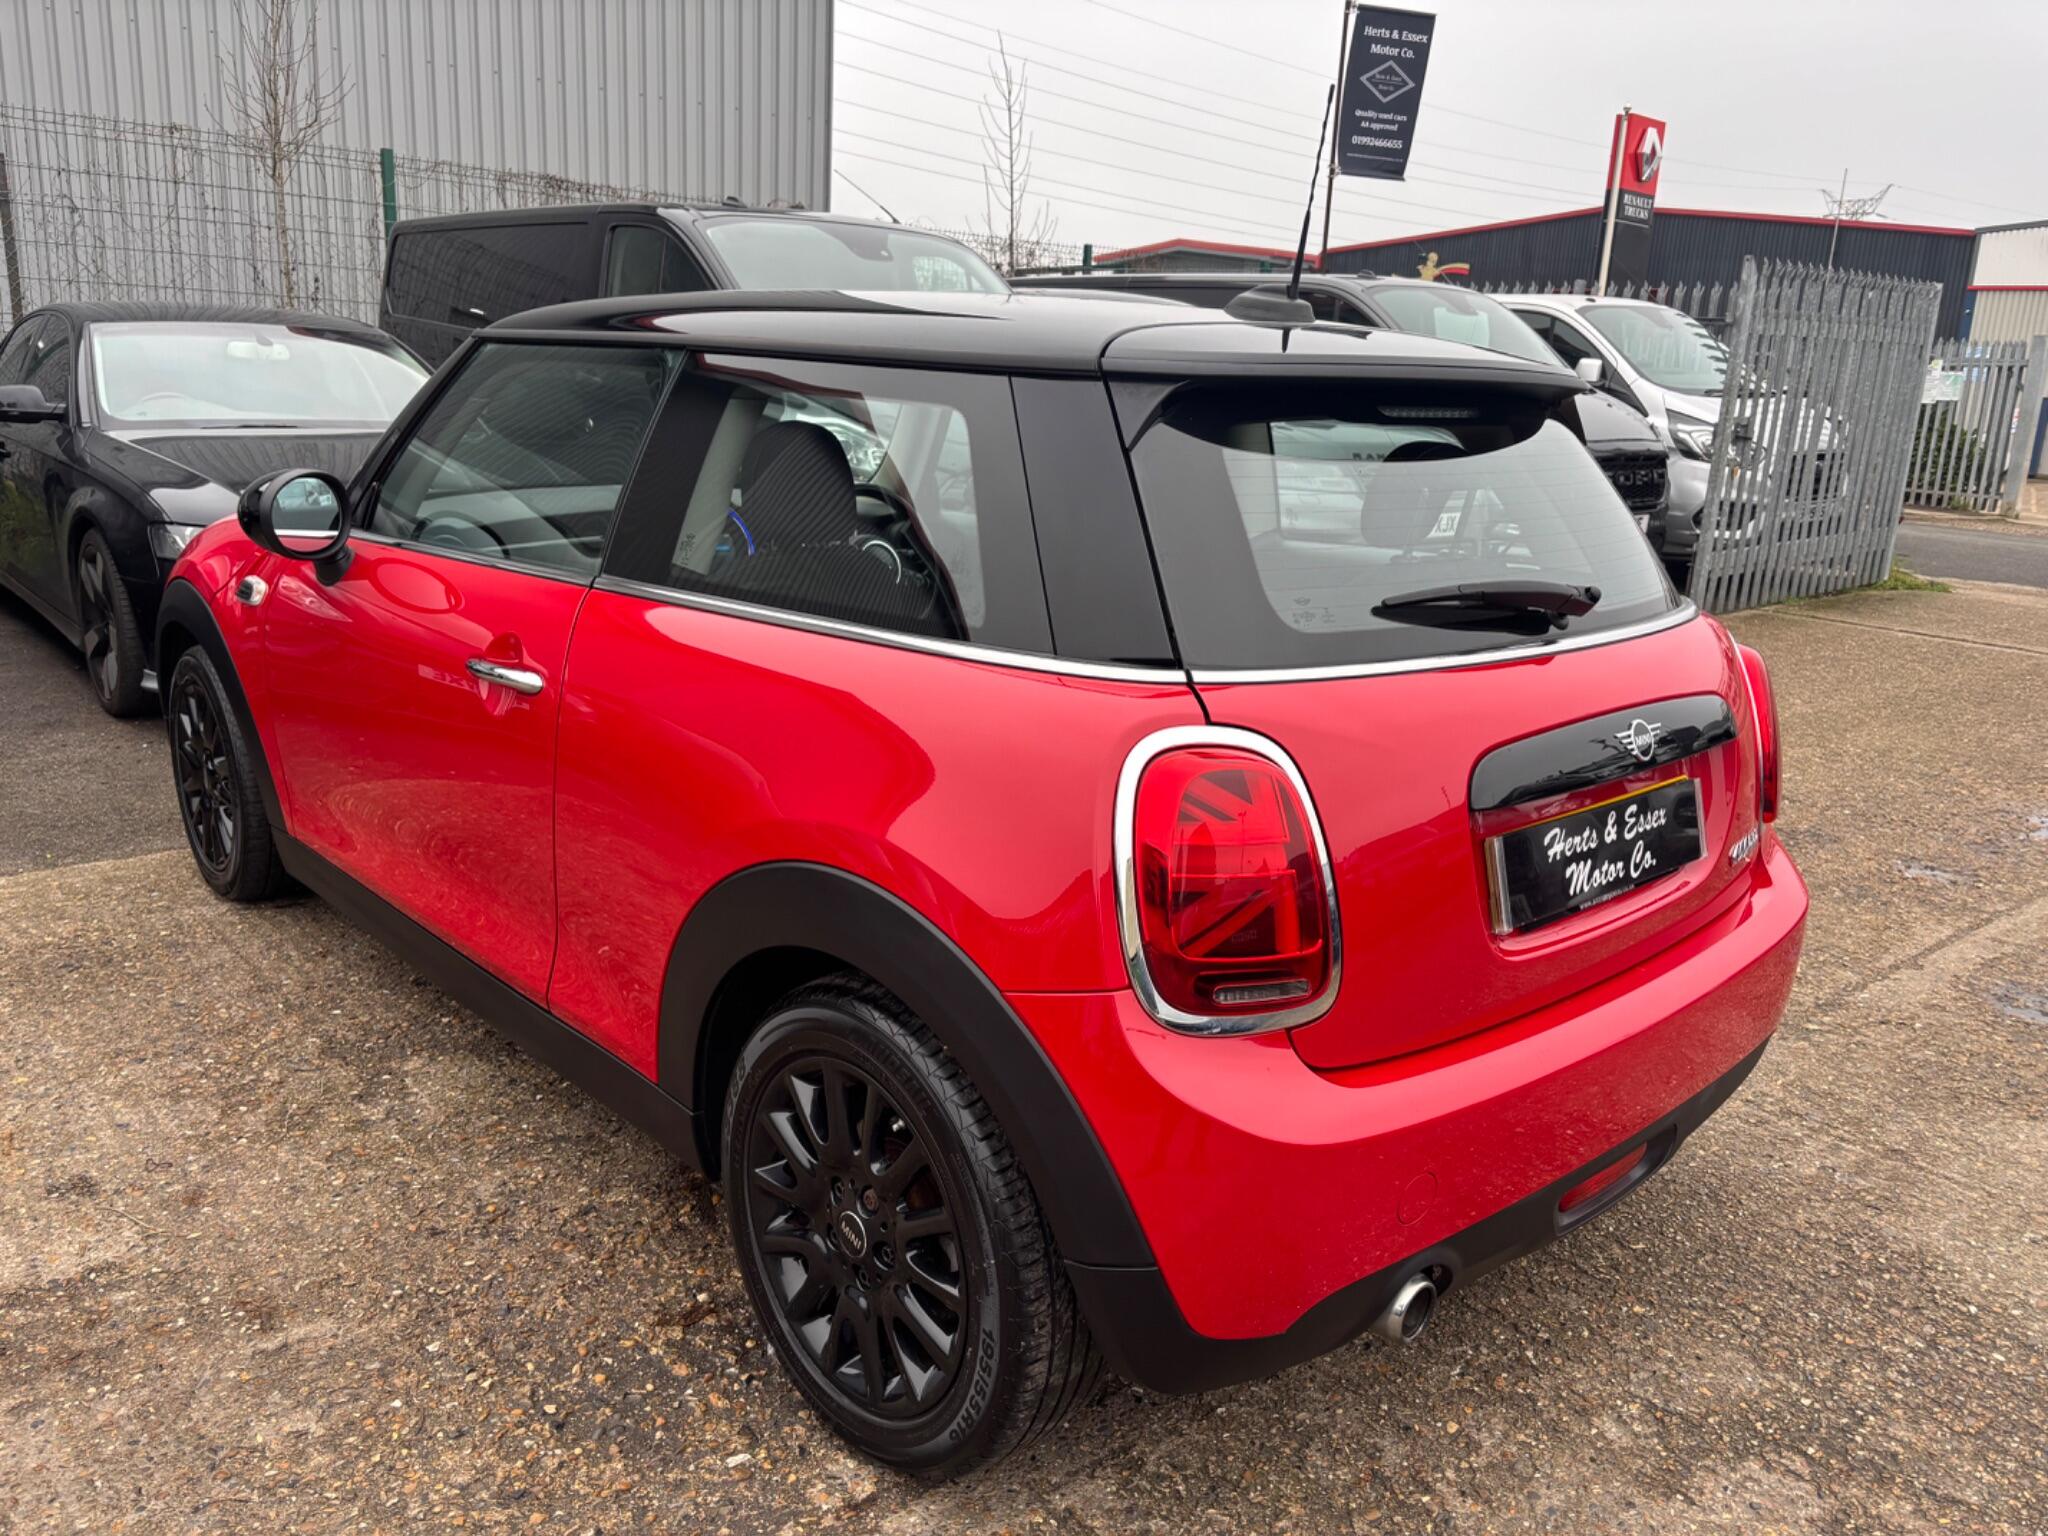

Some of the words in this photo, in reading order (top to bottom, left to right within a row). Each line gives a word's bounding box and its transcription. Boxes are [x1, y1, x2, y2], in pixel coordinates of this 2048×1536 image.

[1364, 26, 1390, 38] Herts
[1391, 30, 1399, 39] &
[1401, 31, 1428, 43] Essex
[1370, 44, 1400, 56] Motor
[1401, 48, 1415, 58] Co.
[1355, 109, 1377, 119] Quality
[1377, 112, 1393, 120] used
[1360, 120, 1370, 128] AA
[1370, 123, 1398, 131] approved
[1623, 193, 1653, 209] RENAULT
[1624, 204, 1649, 220] TRUCKS
[1544, 827, 1598, 863] Herts
[1604, 810, 1617, 844] &
[1624, 803, 1667, 840] Essex
[1565, 858, 1625, 897] Motor
[1630, 840, 1657, 878] Co.
[841, 1220, 862, 1250] MINI
